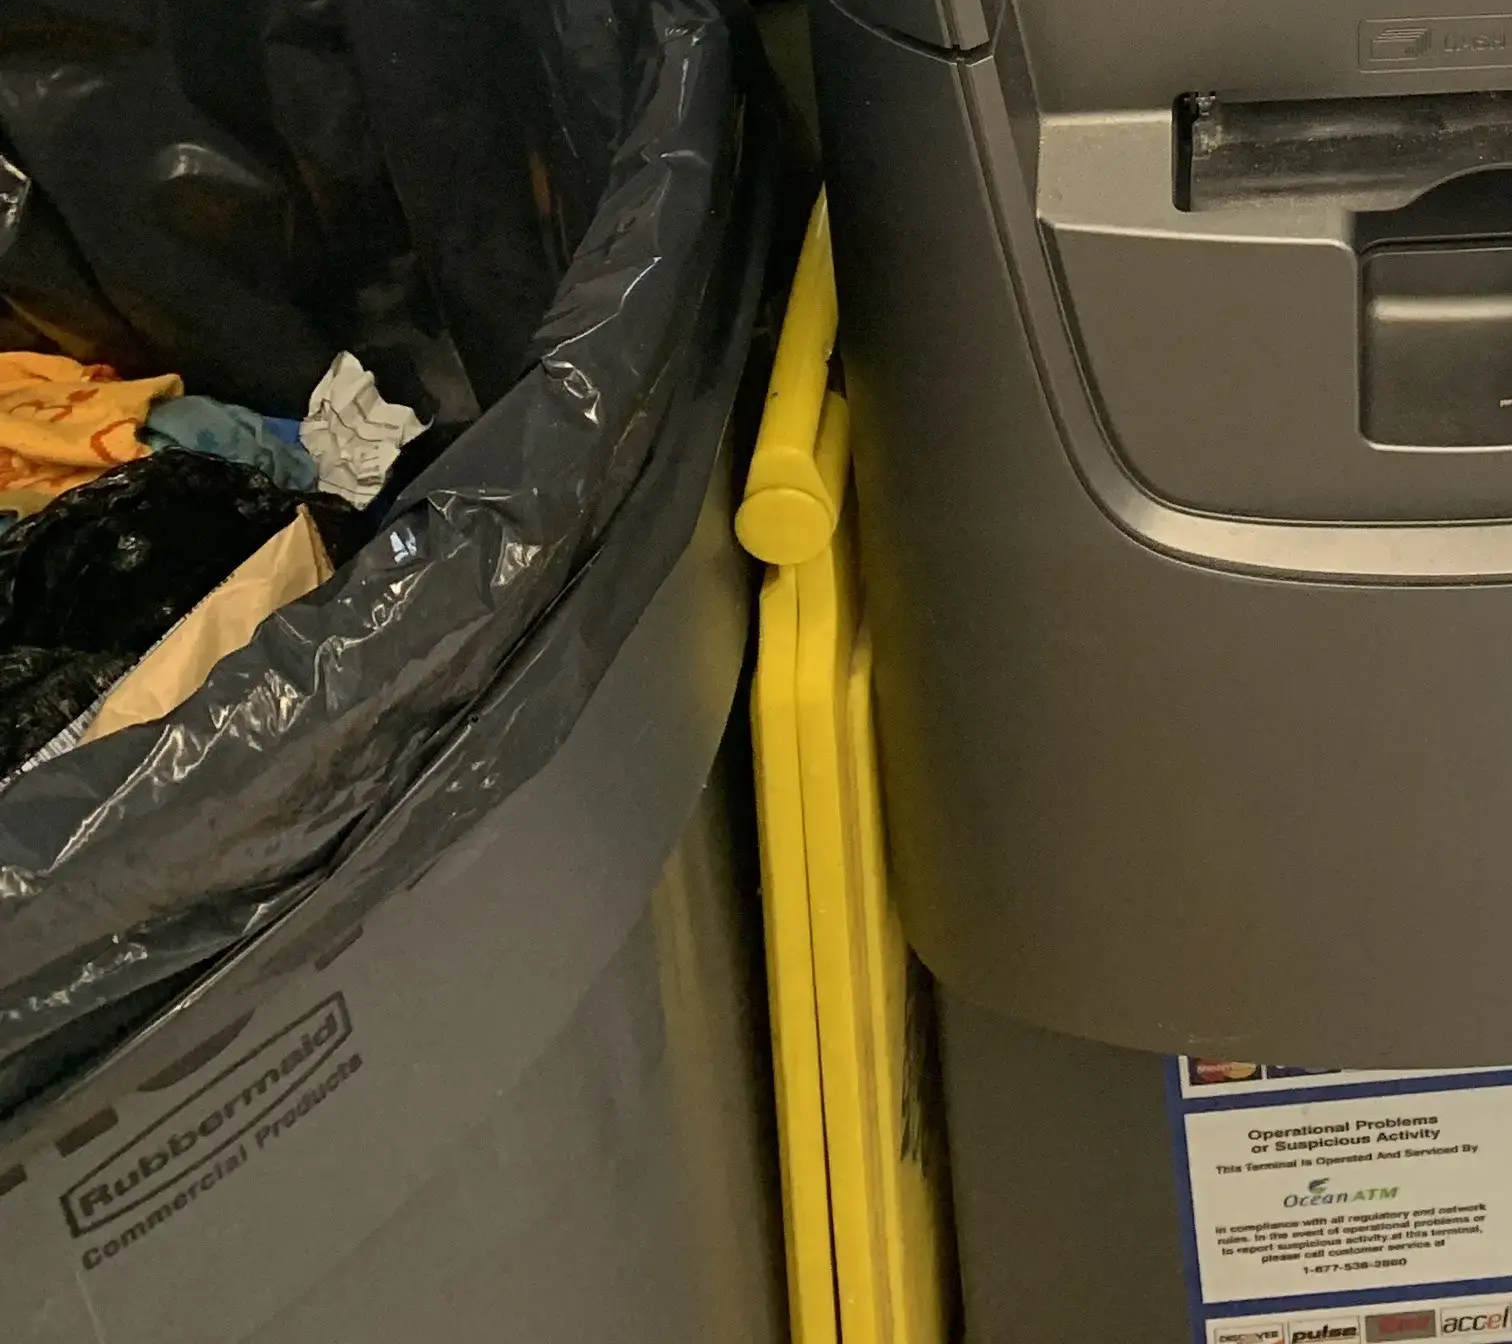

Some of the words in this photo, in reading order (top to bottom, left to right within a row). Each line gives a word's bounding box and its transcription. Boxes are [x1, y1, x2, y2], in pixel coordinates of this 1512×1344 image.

[78, 1011, 340, 1216] Rubbermaid
[1248, 1121, 1349, 1141] Operational
[1355, 1115, 1438, 1131] Problems
[1251, 1143, 1267, 1154] or
[1275, 1135, 1370, 1152] Suspicious
[1376, 1127, 1440, 1143] Activity
[82, 1144, 250, 1270] Commercial
[255, 1052, 364, 1149] Products
[1216, 1164, 1241, 1174] This
[1246, 1159, 1296, 1171] Terminal
[1315, 1152, 1372, 1166] Operated
[1376, 1149, 1400, 1159] And
[1404, 1144, 1458, 1157] Serviced
[1462, 1144, 1478, 1153] By
[1283, 1191, 1347, 1208] Ocean
[1351, 1186, 1399, 1202] ATM
[1348, 1211, 1408, 1223] regulatory
[1413, 1217, 1469, 1229] problems
[1405, 1229, 1427, 1239] this
[1443, 1306, 1508, 1333] accel
[1293, 1324, 1357, 1344] pulse
